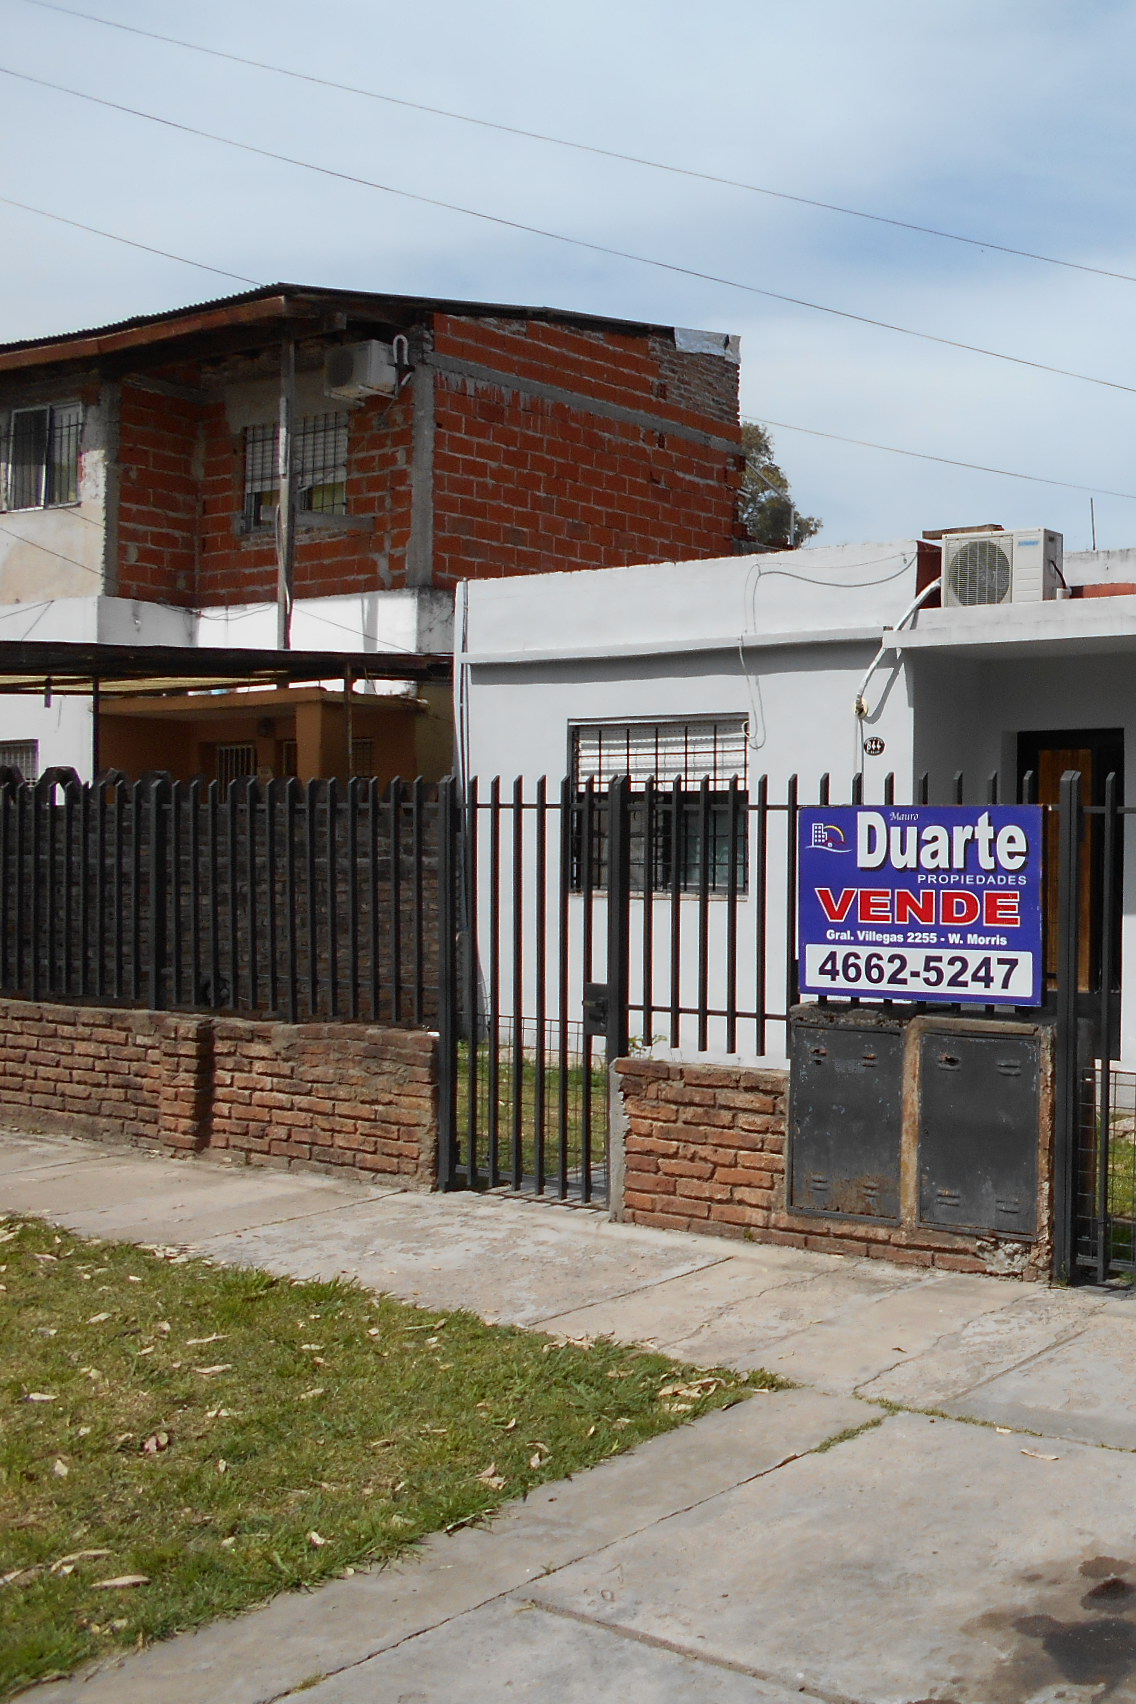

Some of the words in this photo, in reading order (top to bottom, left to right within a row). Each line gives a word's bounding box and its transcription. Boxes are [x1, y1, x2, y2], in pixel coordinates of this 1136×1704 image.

[889, 811, 919, 821] Mauro
[857, 811, 1028, 870] Duarte
[917, 874, 1027, 885] PROPIEDADES
[814, 888, 1021, 927] VENDE
[826, 930, 854, 941] Gral.
[857, 930, 904, 944] Villegas
[907, 932, 937, 943] 2255
[948, 933, 964, 944] W.
[967, 934, 1008, 945] Morris
[818, 950, 1019, 990] 4662-5247
